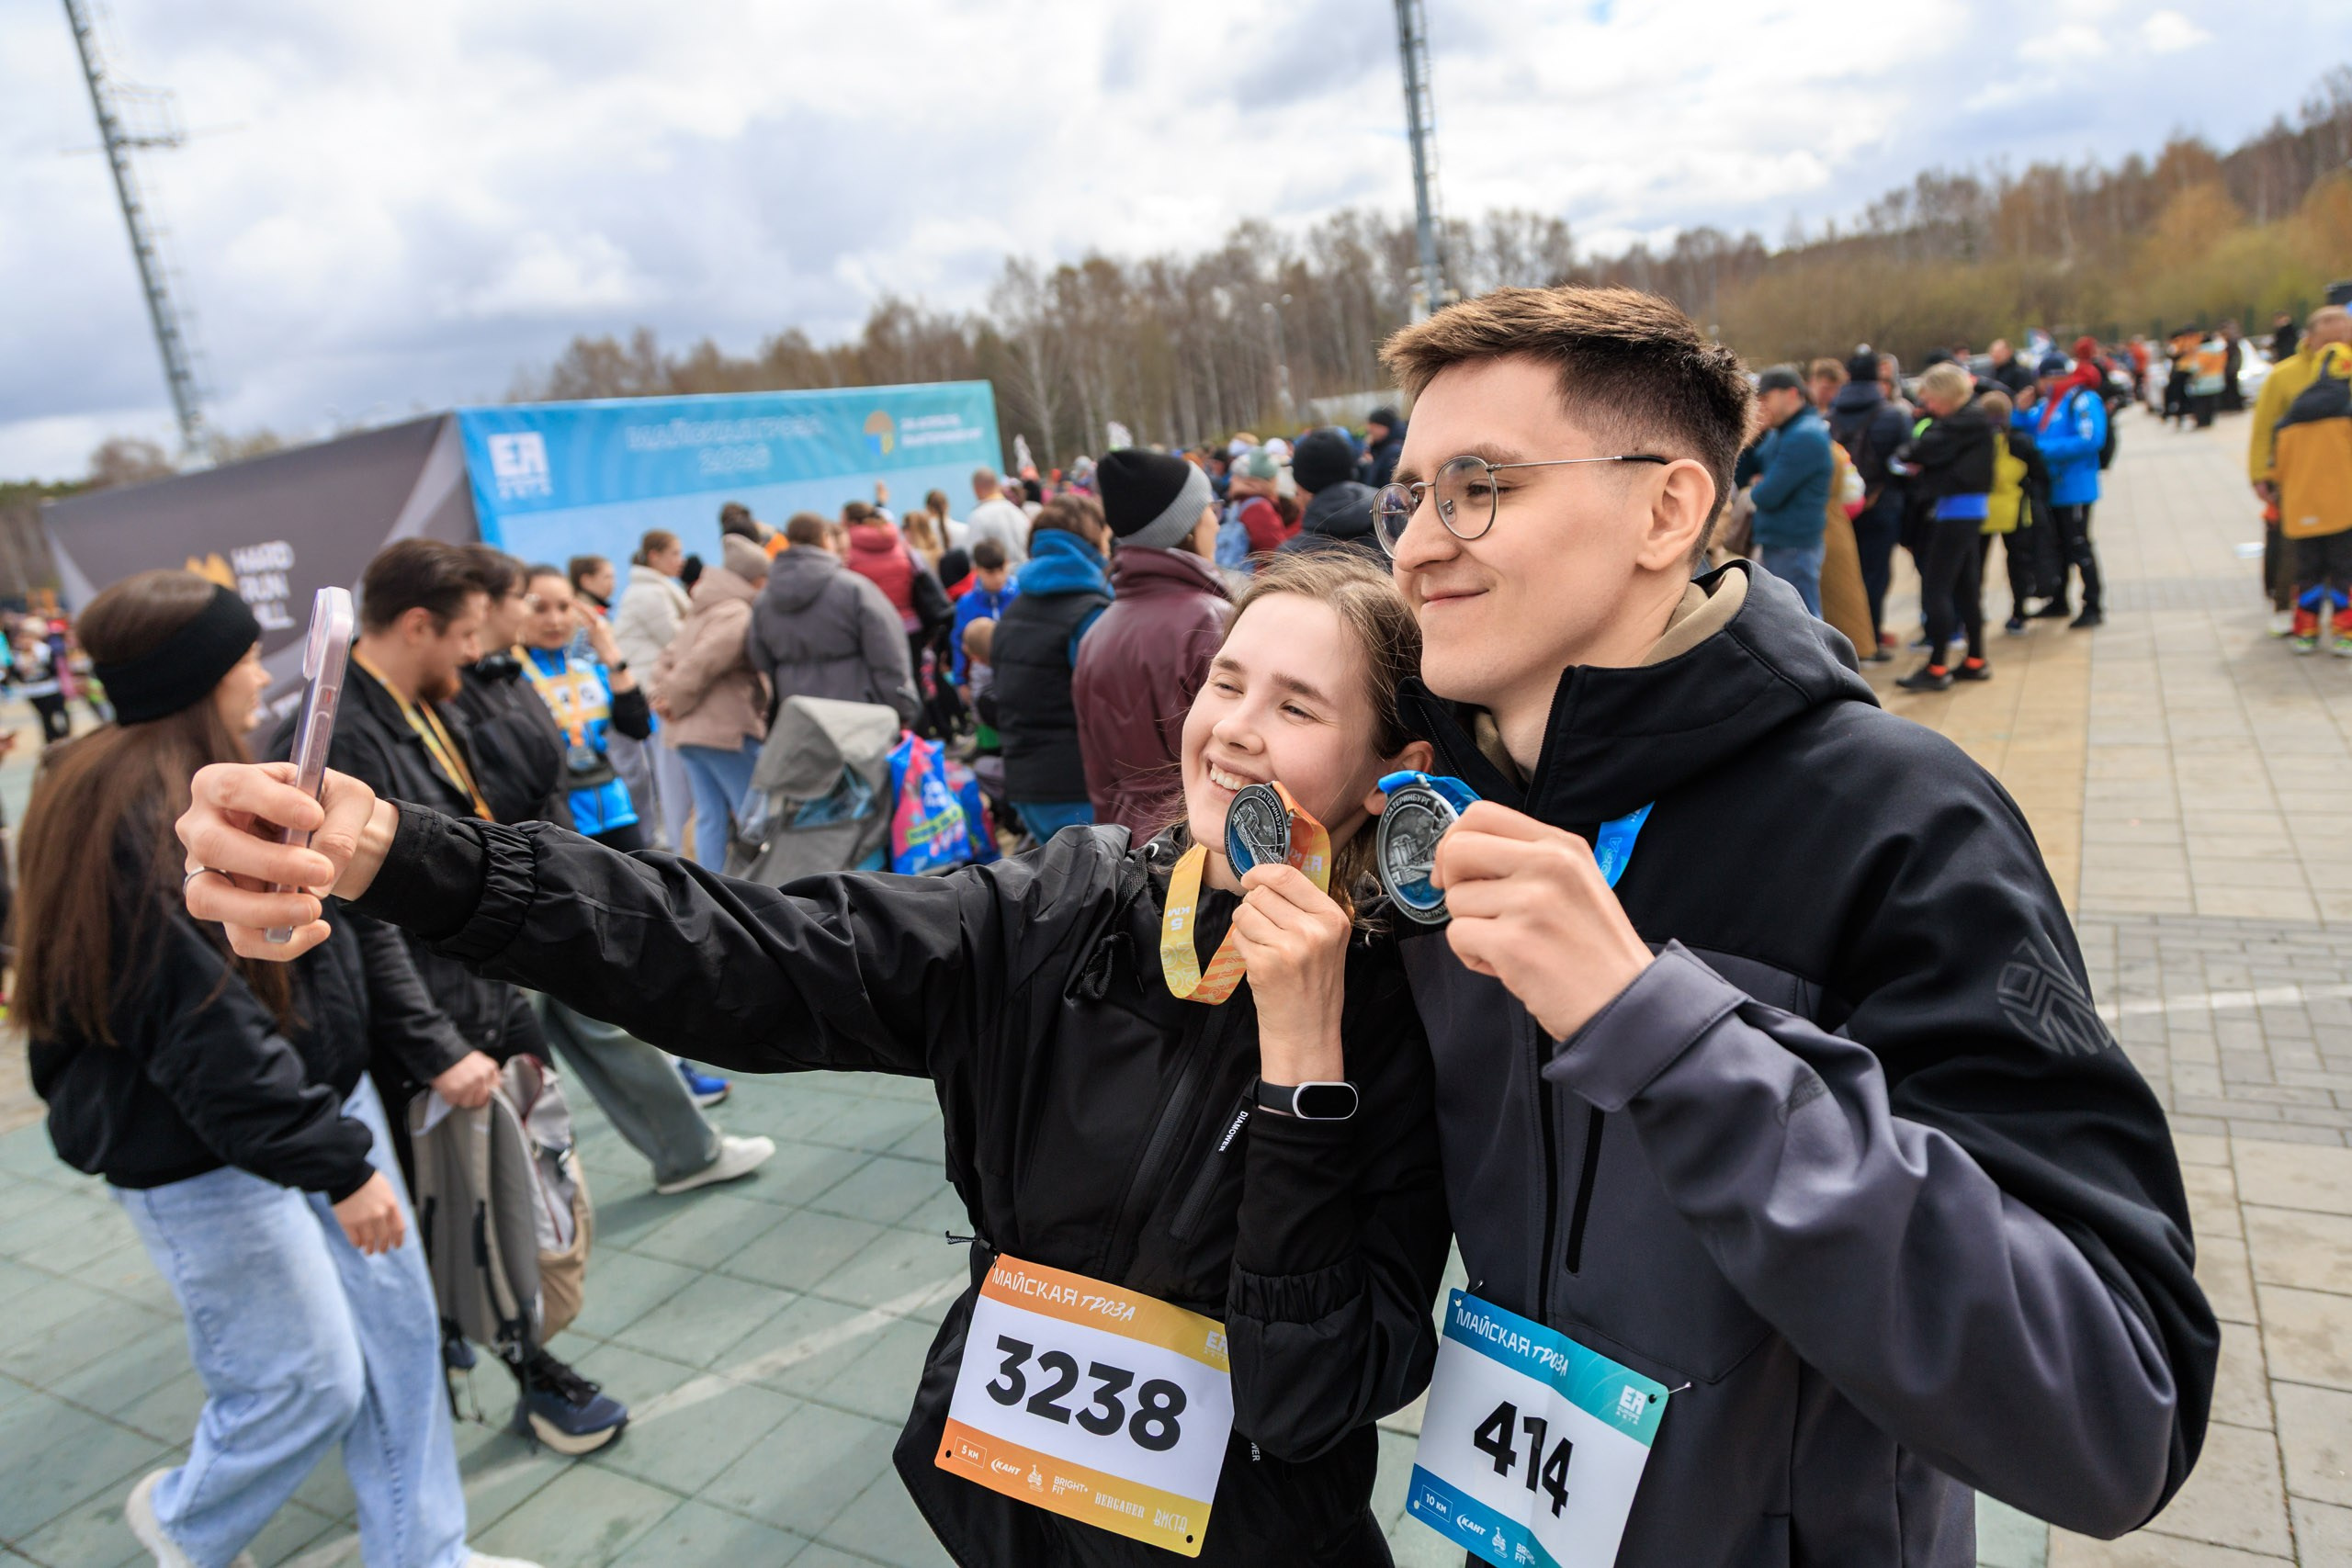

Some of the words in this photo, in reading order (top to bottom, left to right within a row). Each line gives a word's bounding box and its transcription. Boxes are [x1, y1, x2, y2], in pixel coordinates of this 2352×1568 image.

[230, 540, 295, 575] HARD
[238, 571, 290, 604] RUN
[1256, 789, 1284, 837] ЕКАТЕРИНБУРГ
[1384, 793, 1431, 823] ЕКАТЕРИНБУРГ
[1218, 1111, 1249, 1152] DIAMOWER
[991, 1268, 1078, 1306] МАЙСКАЯ
[1080, 1295, 1136, 1322] ГРОЗА
[1456, 1308, 1532, 1357] МАЙСКАЯ
[1532, 1346, 1569, 1376] ГРОЗА
[986, 1335, 1187, 1451] 3238
[961, 1445, 968, 1455] 5
[1474, 1401, 1574, 1519] 414
[996, 1461, 1022, 1476] КАНТ
[1051, 1484, 1066, 1496] FIT
[1426, 1493, 1435, 1506] 10
[1094, 1492, 1145, 1519] BERGAUER
[1153, 1508, 1188, 1534] ВИСТА
[1461, 1517, 1487, 1536] КАНТ
[1514, 1551, 1526, 1565] FIT
